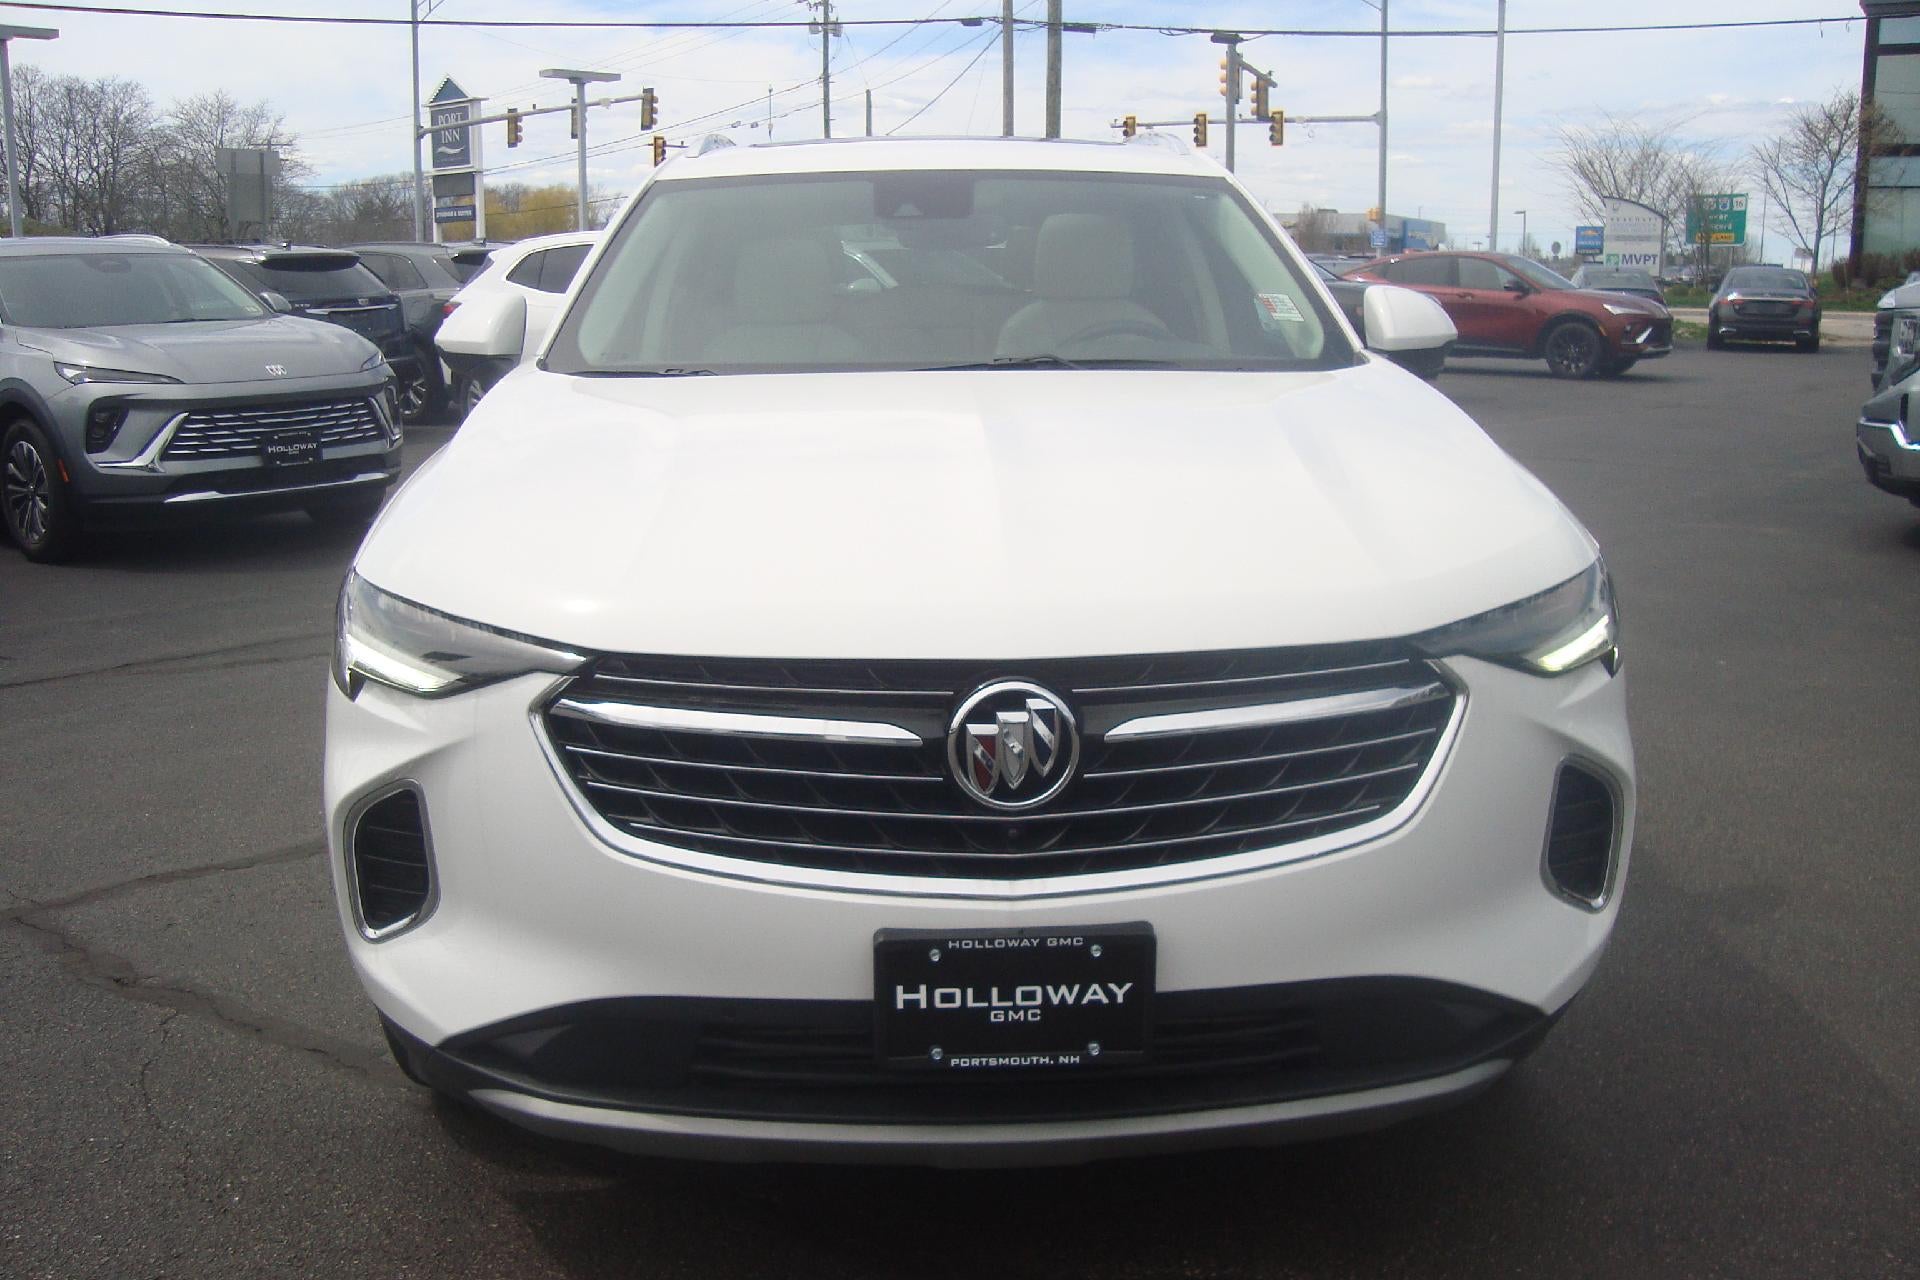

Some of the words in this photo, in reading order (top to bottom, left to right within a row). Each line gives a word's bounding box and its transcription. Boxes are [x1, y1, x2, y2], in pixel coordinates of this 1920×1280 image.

[438, 112, 463, 126] PORT
[441, 128, 460, 144] INN
[1621, 254, 1658, 265] MVPT
[268, 442, 318, 454] HOLLOWAY
[948, 938, 1040, 950] HOLLOWAY
[1047, 937, 1084, 947] GMC
[895, 982, 1134, 1010] HOLLOWAY
[990, 1009, 1042, 1022] GMC
[1059, 1055, 1080, 1065] NH
